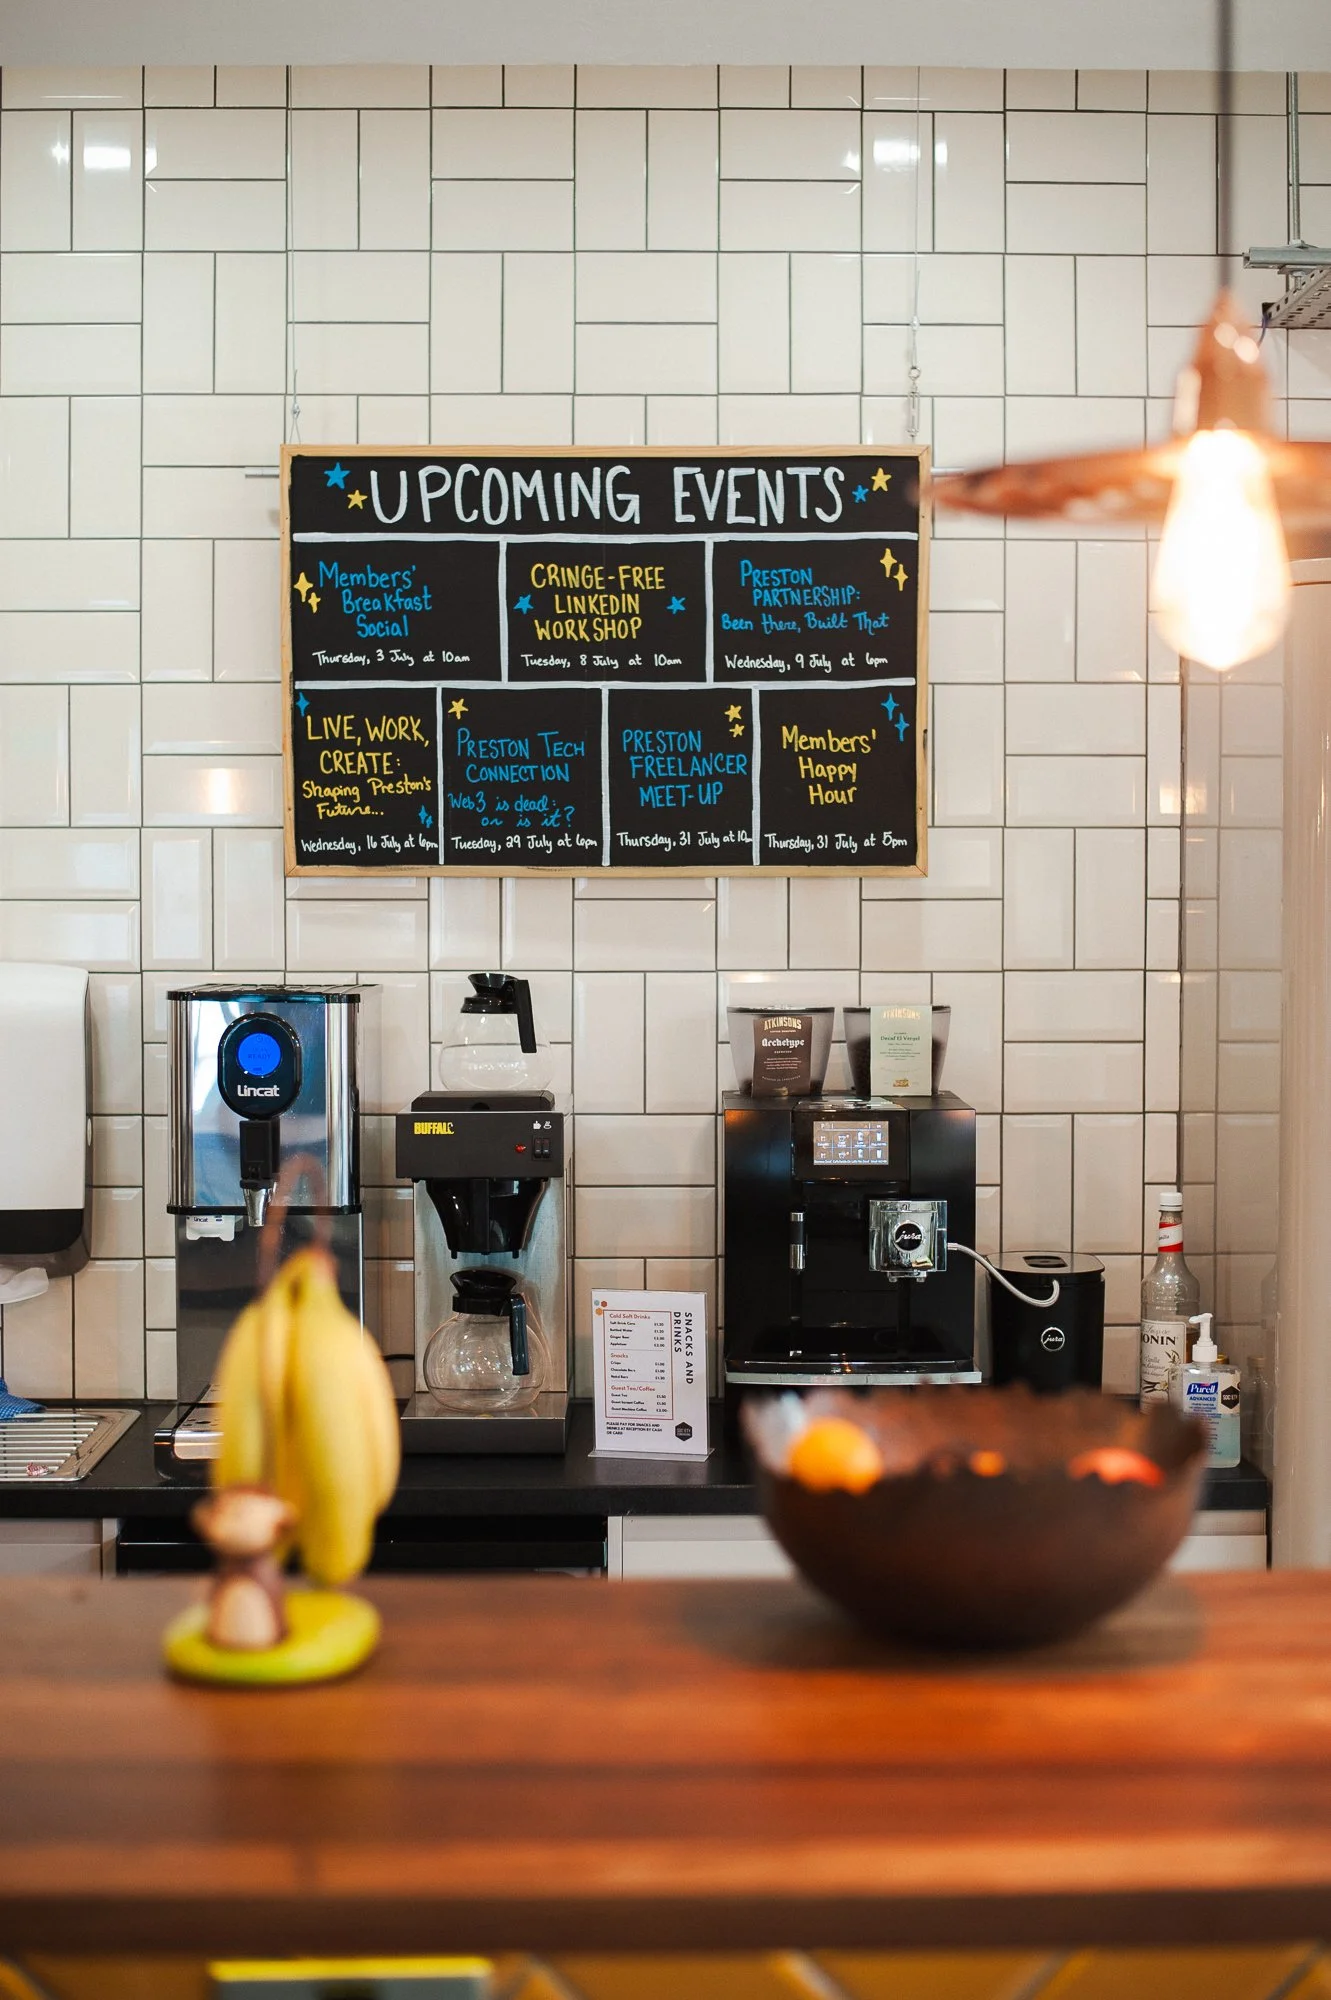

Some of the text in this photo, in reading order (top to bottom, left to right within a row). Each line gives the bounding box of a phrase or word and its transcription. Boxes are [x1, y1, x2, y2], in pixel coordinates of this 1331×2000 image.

[370, 464, 844, 526] UPCOMING EVENTS
[319, 561, 416, 589] Members'
[530, 563, 666, 590] CRINGE-FREE
[342, 586, 432, 614] Breakfast
[555, 593, 640, 615] LINKEDIN
[753, 585, 860, 607] PARTNERSHIP:
[356, 615, 408, 637] Social
[721, 611, 889, 635] Been there, Built That
[312, 650, 470, 666] Thursday, 3 July at 10am
[521, 654, 681, 668] Tuesday, 8 July at 10am
[725, 653, 888, 672] Wednesday, 9 July at 6pm
[307, 715, 430, 747] LIVE, WORK,
[622, 729, 701, 753] PRESTON
[782, 725, 876, 753] Members'
[319, 751, 401, 775] CREATE:
[466, 763, 569, 783] CONNECTION
[630, 753, 747, 779] FREELANCER
[799, 756, 856, 783] Happy
[302, 774, 431, 801] Shaping Preston's
[640, 782, 723, 808] MEET-UP
[809, 785, 856, 805] Hour
[317, 803, 384, 820] Future...
[496, 796, 509, 811] is
[481, 806, 575, 828] or is it?
[301, 835, 438, 855] Wednesday, 16 July at 6pm
[451, 835, 597, 854] Tuesday, 29 July at 6pm
[617, 832, 676, 852] Thursday,
[679, 831, 690, 845] 31
[697, 831, 720, 848] July
[723, 830, 736, 843] at
[764, 831, 907, 853] Thursday, 31 July at 5pm
[764, 1016, 801, 1030] ATKINSONS
[674, 1312, 682, 1352] DRINKS
[685, 1312, 693, 1357] SNACKS
[1142, 1334, 1176, 1345] ONIN
[1190, 1384, 1216, 1393] Purell
